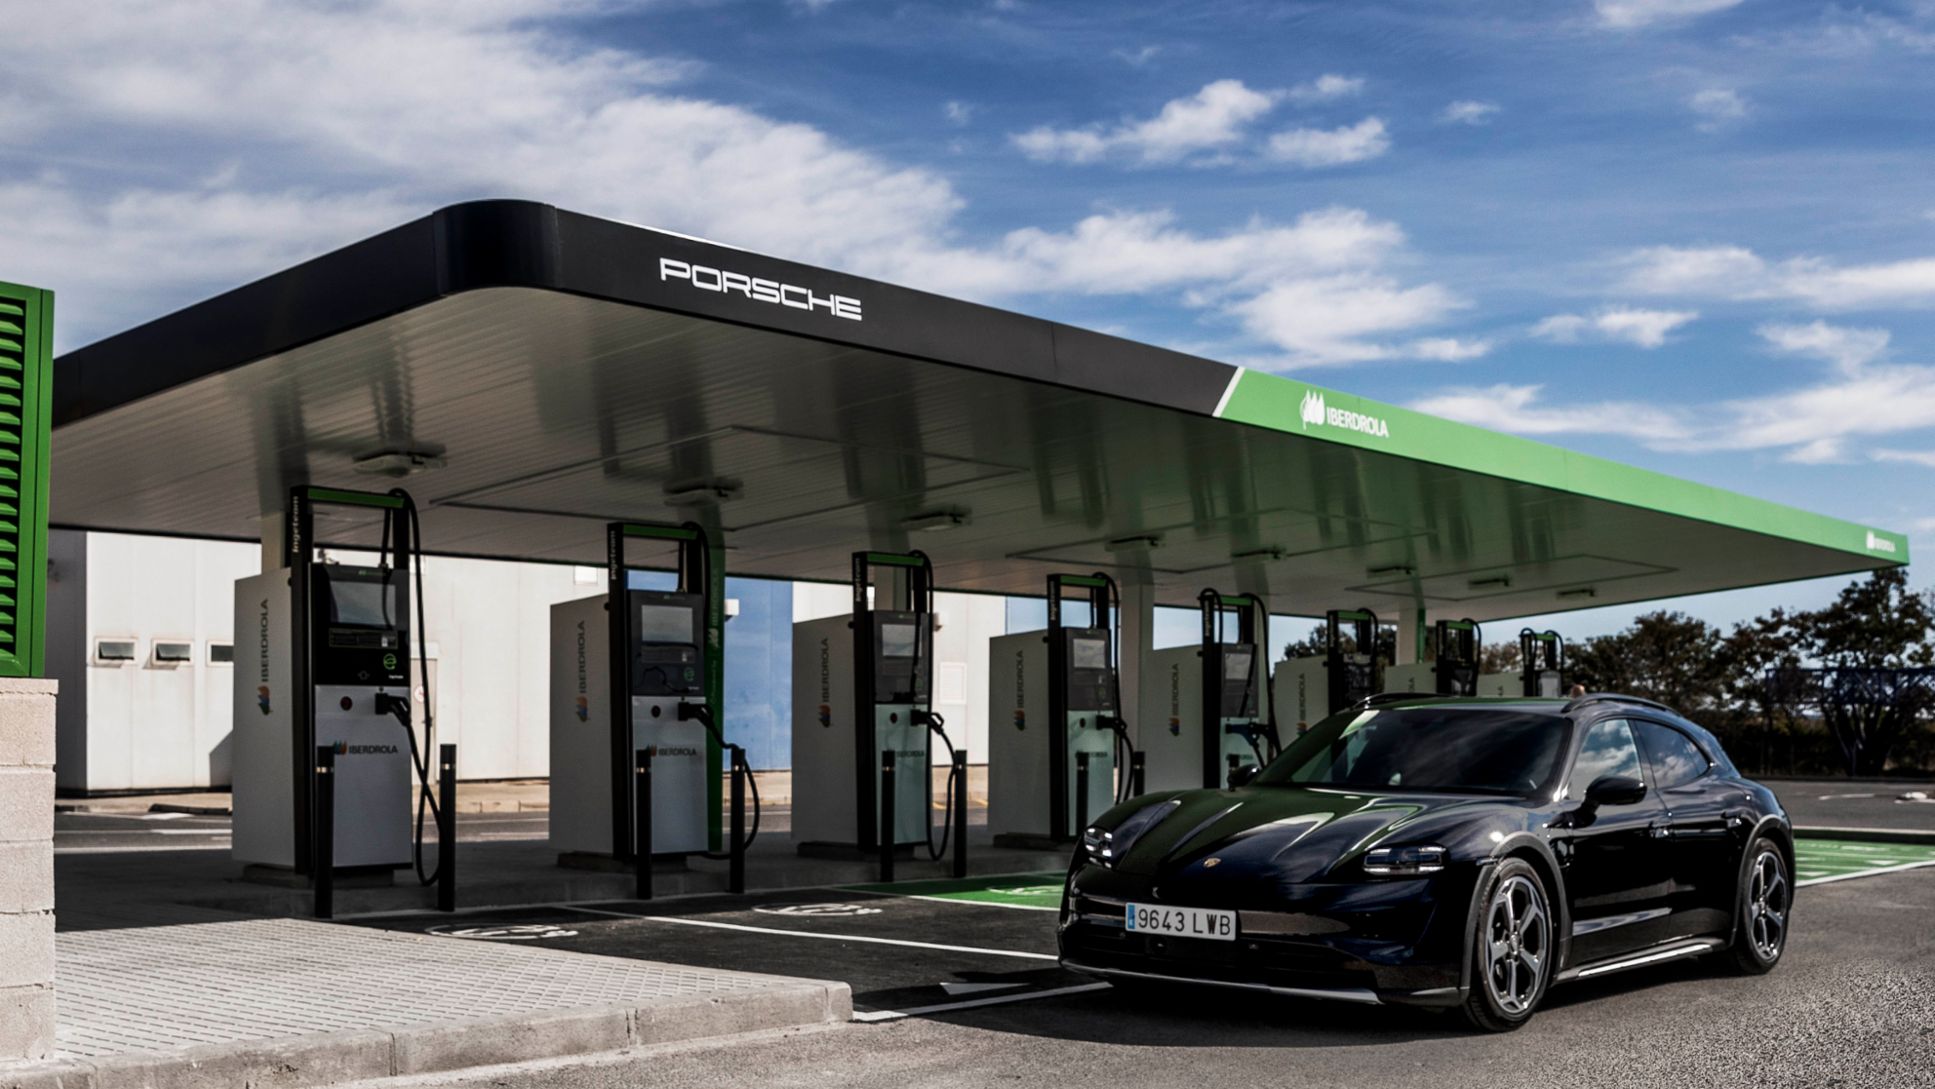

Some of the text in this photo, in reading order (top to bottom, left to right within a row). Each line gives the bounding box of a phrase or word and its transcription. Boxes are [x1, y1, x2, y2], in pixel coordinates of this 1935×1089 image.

[660, 257, 862, 321] PORSCHE
[1326, 406, 1389, 438] IBERDROLA
[292, 495, 300, 553] Ingeteam
[260, 598, 269, 683] IBERDROLA
[577, 620, 587, 694] IBERDROLA
[821, 637, 830, 703] IBERDROLA
[1016, 650, 1025, 708] IBERDROLA
[348, 745, 399, 754] IBERDROLA
[658, 748, 697, 757] IBERDROLA
[1138, 908, 1231, 936] 9643 LWB
